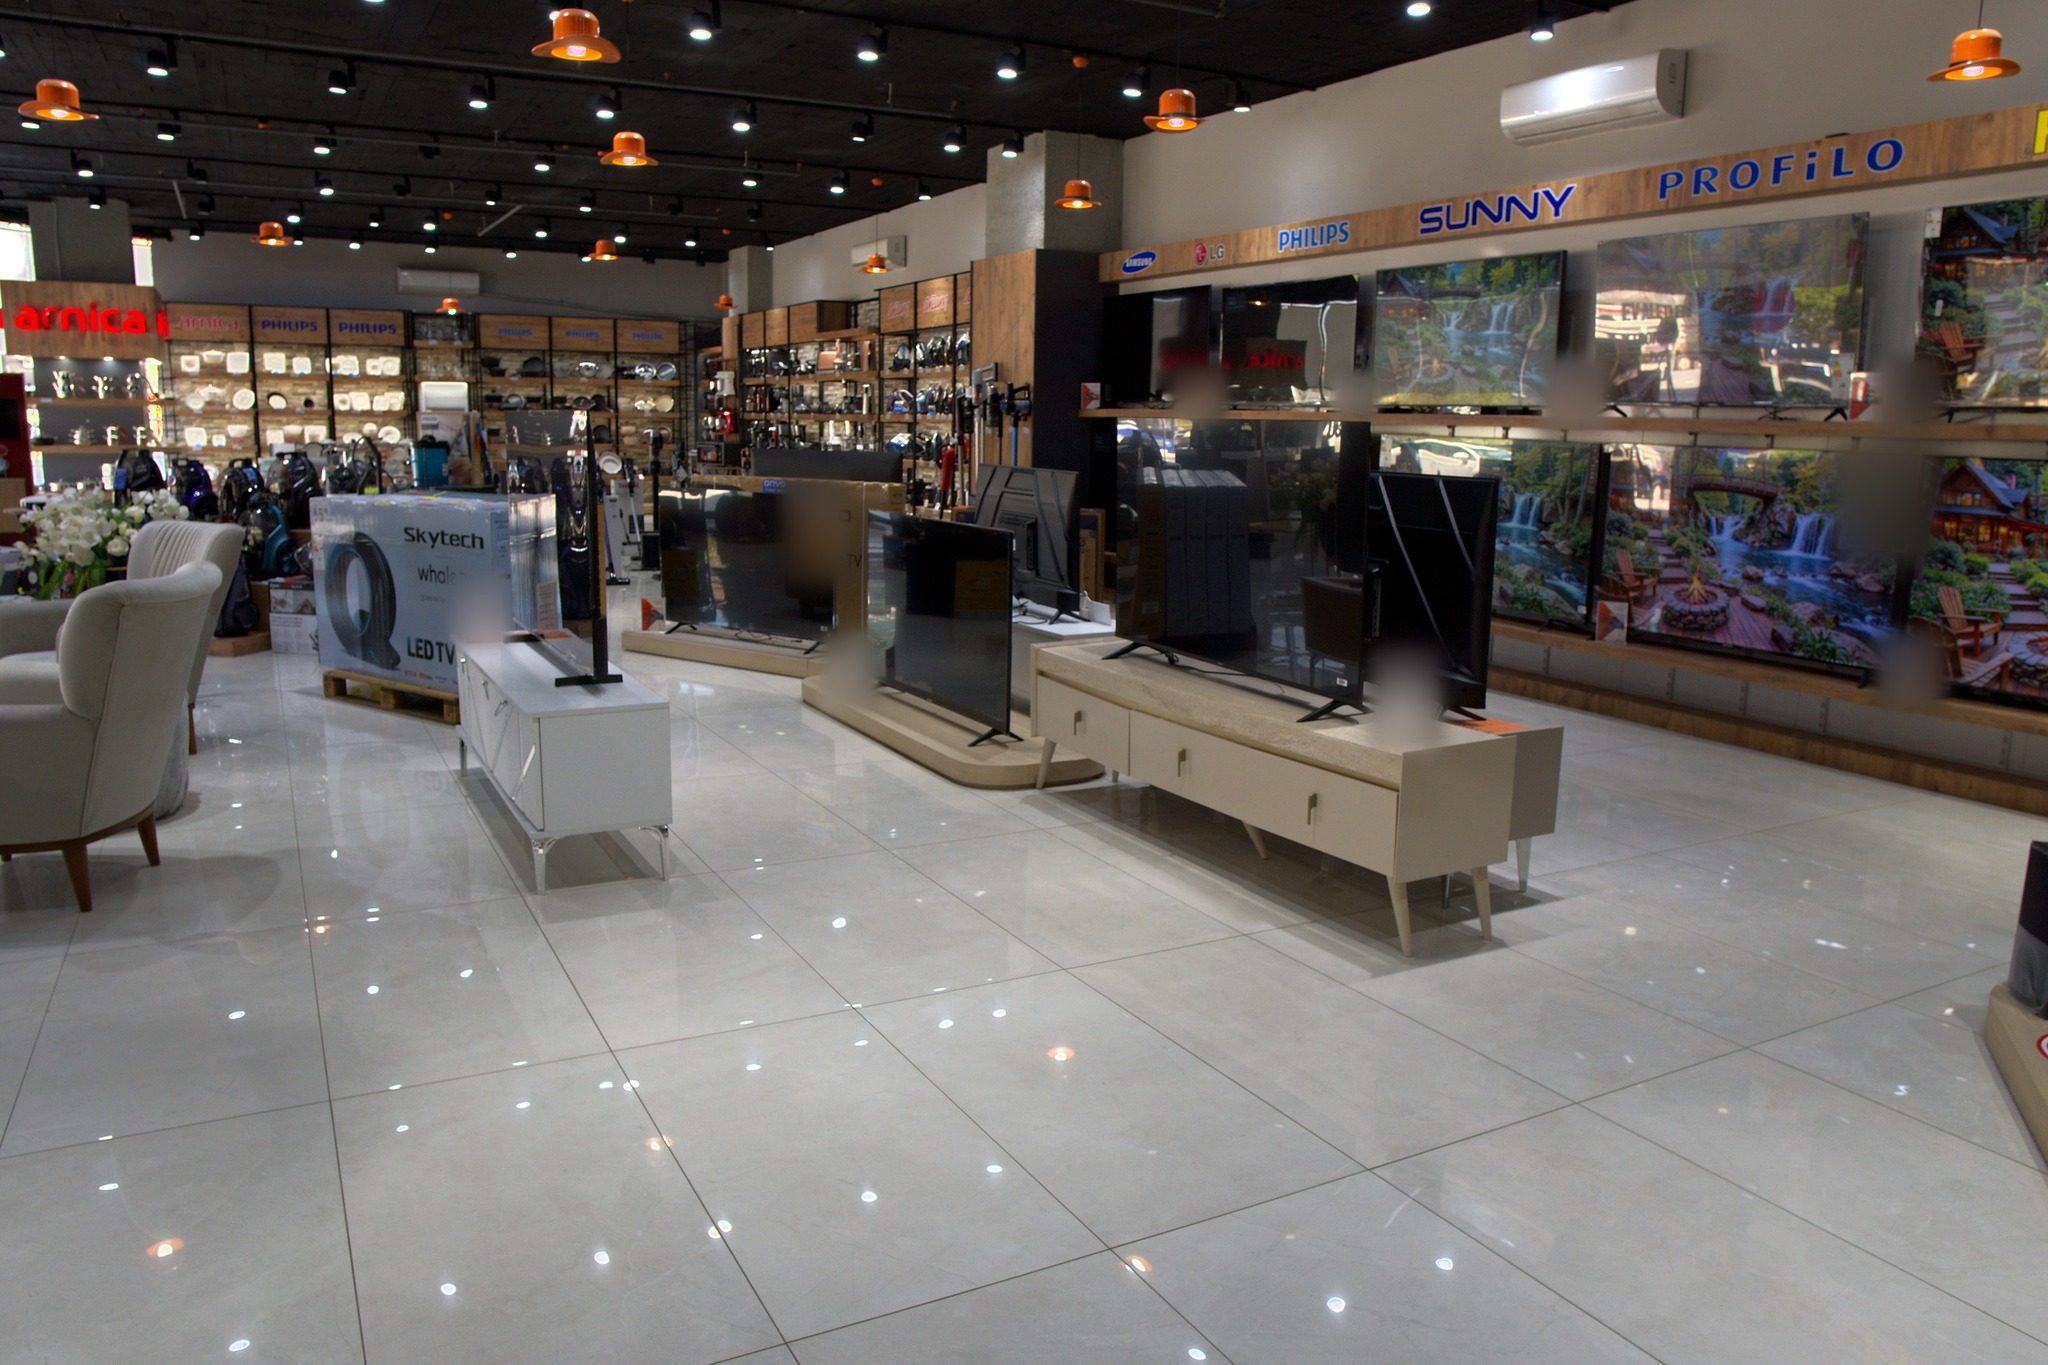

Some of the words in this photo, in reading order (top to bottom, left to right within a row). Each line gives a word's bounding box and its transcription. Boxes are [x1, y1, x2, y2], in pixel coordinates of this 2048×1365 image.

[1419, 184, 1576, 235] SUNNY
[1279, 221, 1350, 251] PHILIPS
[1125, 256, 1153, 268] SAMSUNG
[1209, 245, 1224, 260] LG
[14, 301, 148, 334] arnica
[260, 318, 318, 333] PHILIPS
[338, 321, 397, 335] PHILIPS
[403, 526, 485, 550] Skytech
[407, 636, 434, 661] LED
[435, 640, 455, 665] TV
